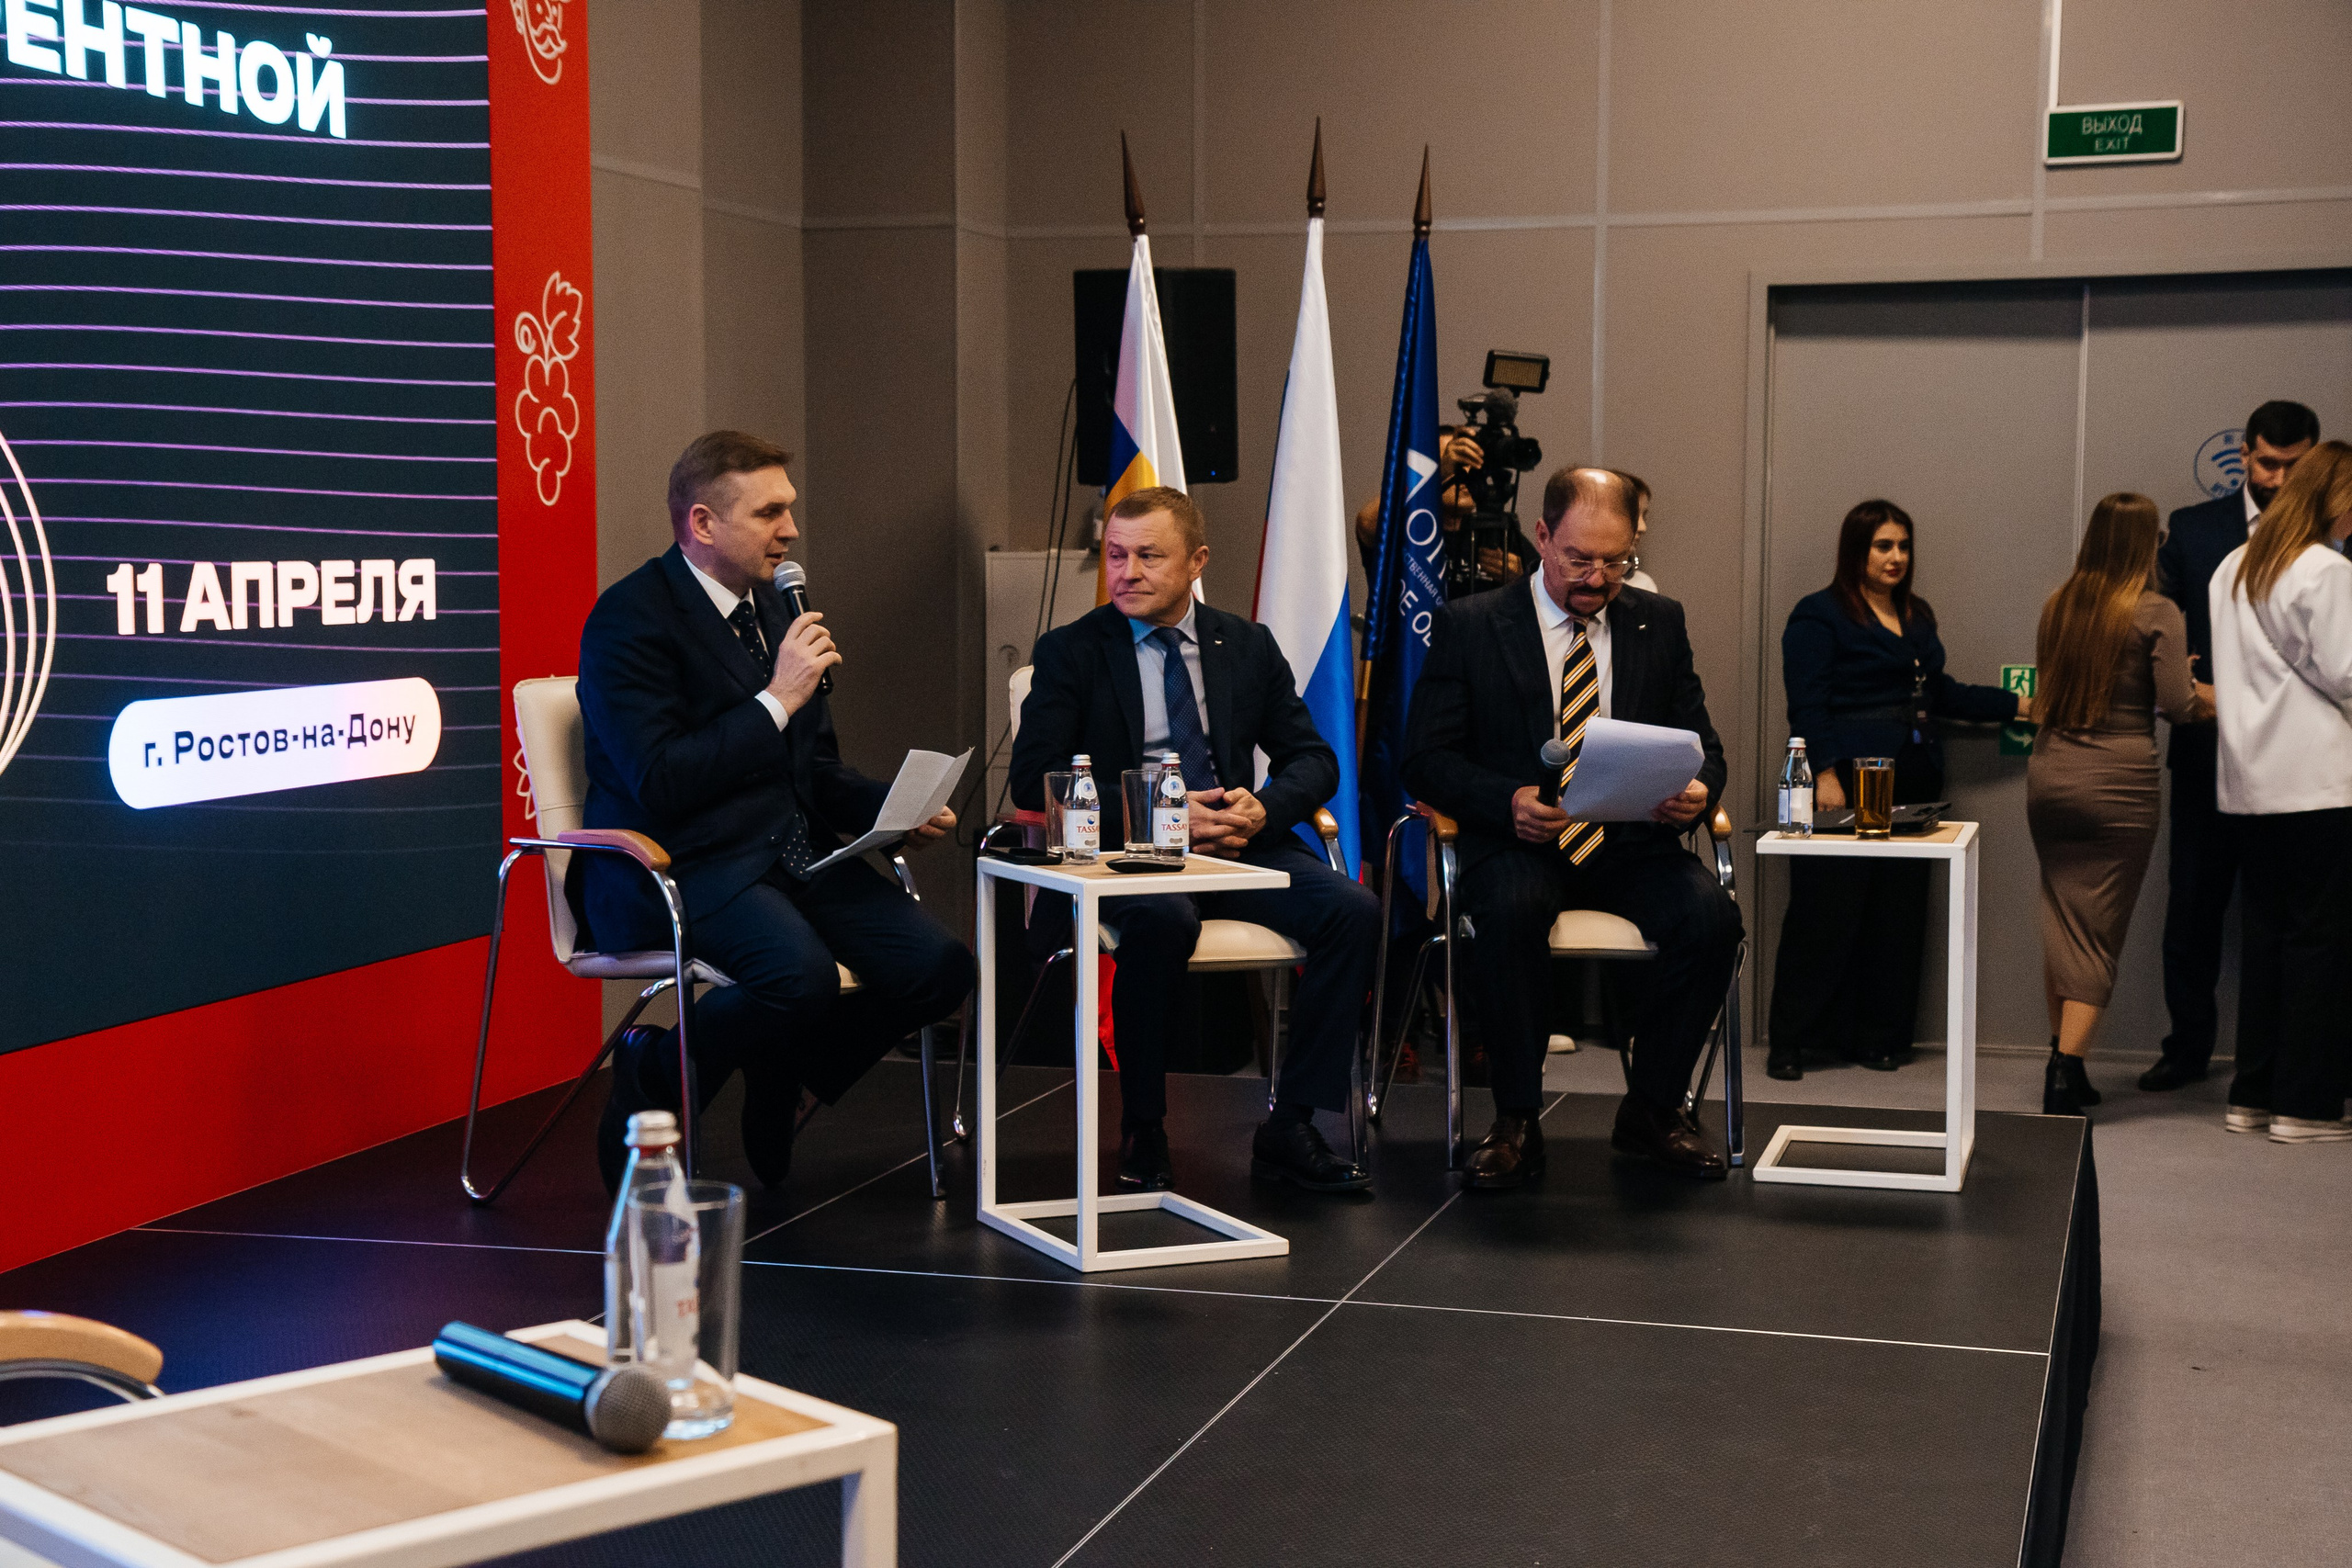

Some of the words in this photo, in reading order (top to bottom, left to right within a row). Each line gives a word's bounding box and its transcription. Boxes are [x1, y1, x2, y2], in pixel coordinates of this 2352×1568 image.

[3, 0, 347, 139] ЕНТНОЙ
[2082, 114, 2143, 136] ВЫХОД
[2094, 135, 2131, 152] EXIT
[107, 562, 164, 636] 11
[179, 558, 437, 633] АПРЕЛЯ
[144, 741, 164, 768] г.
[174, 713, 416, 765] Ростов-на-Дону
